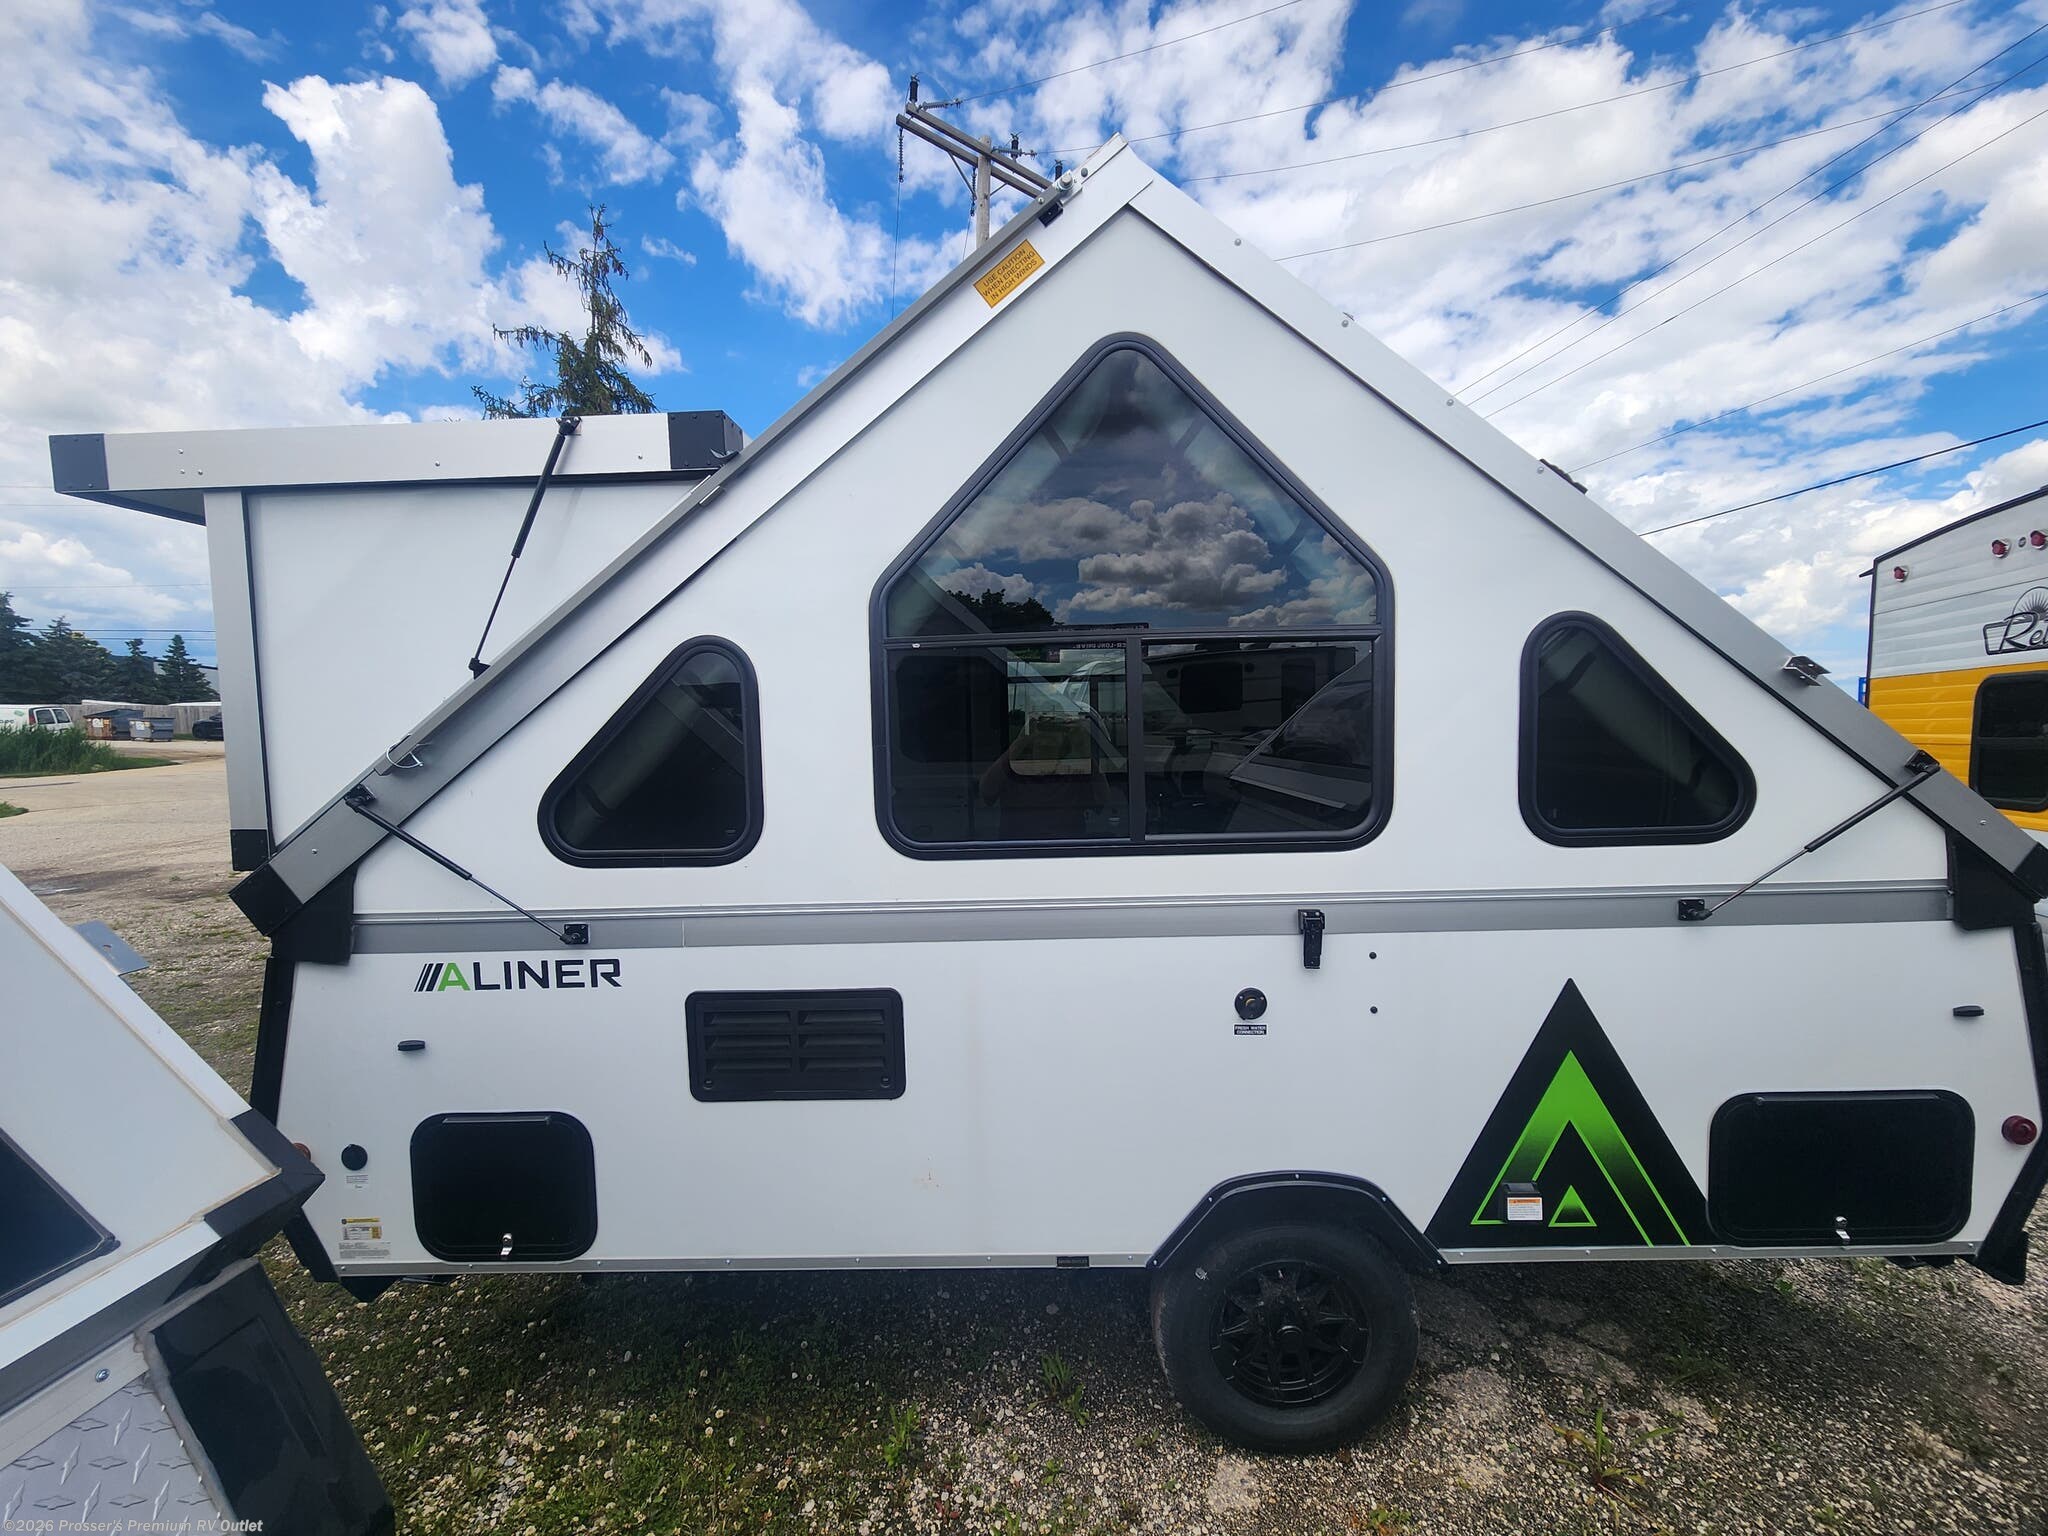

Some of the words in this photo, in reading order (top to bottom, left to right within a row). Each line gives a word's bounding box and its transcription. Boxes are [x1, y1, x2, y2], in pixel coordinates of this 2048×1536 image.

[983, 273, 998, 287] USE
[997, 248, 1026, 276] CAUTION
[983, 277, 1004, 297] WHEN
[1003, 251, 1036, 280] ERECTING
[991, 293, 999, 301] IN
[999, 278, 1016, 293] HIGH
[1015, 259, 1038, 280] WINDS
[437, 958, 622, 992] ALINER
